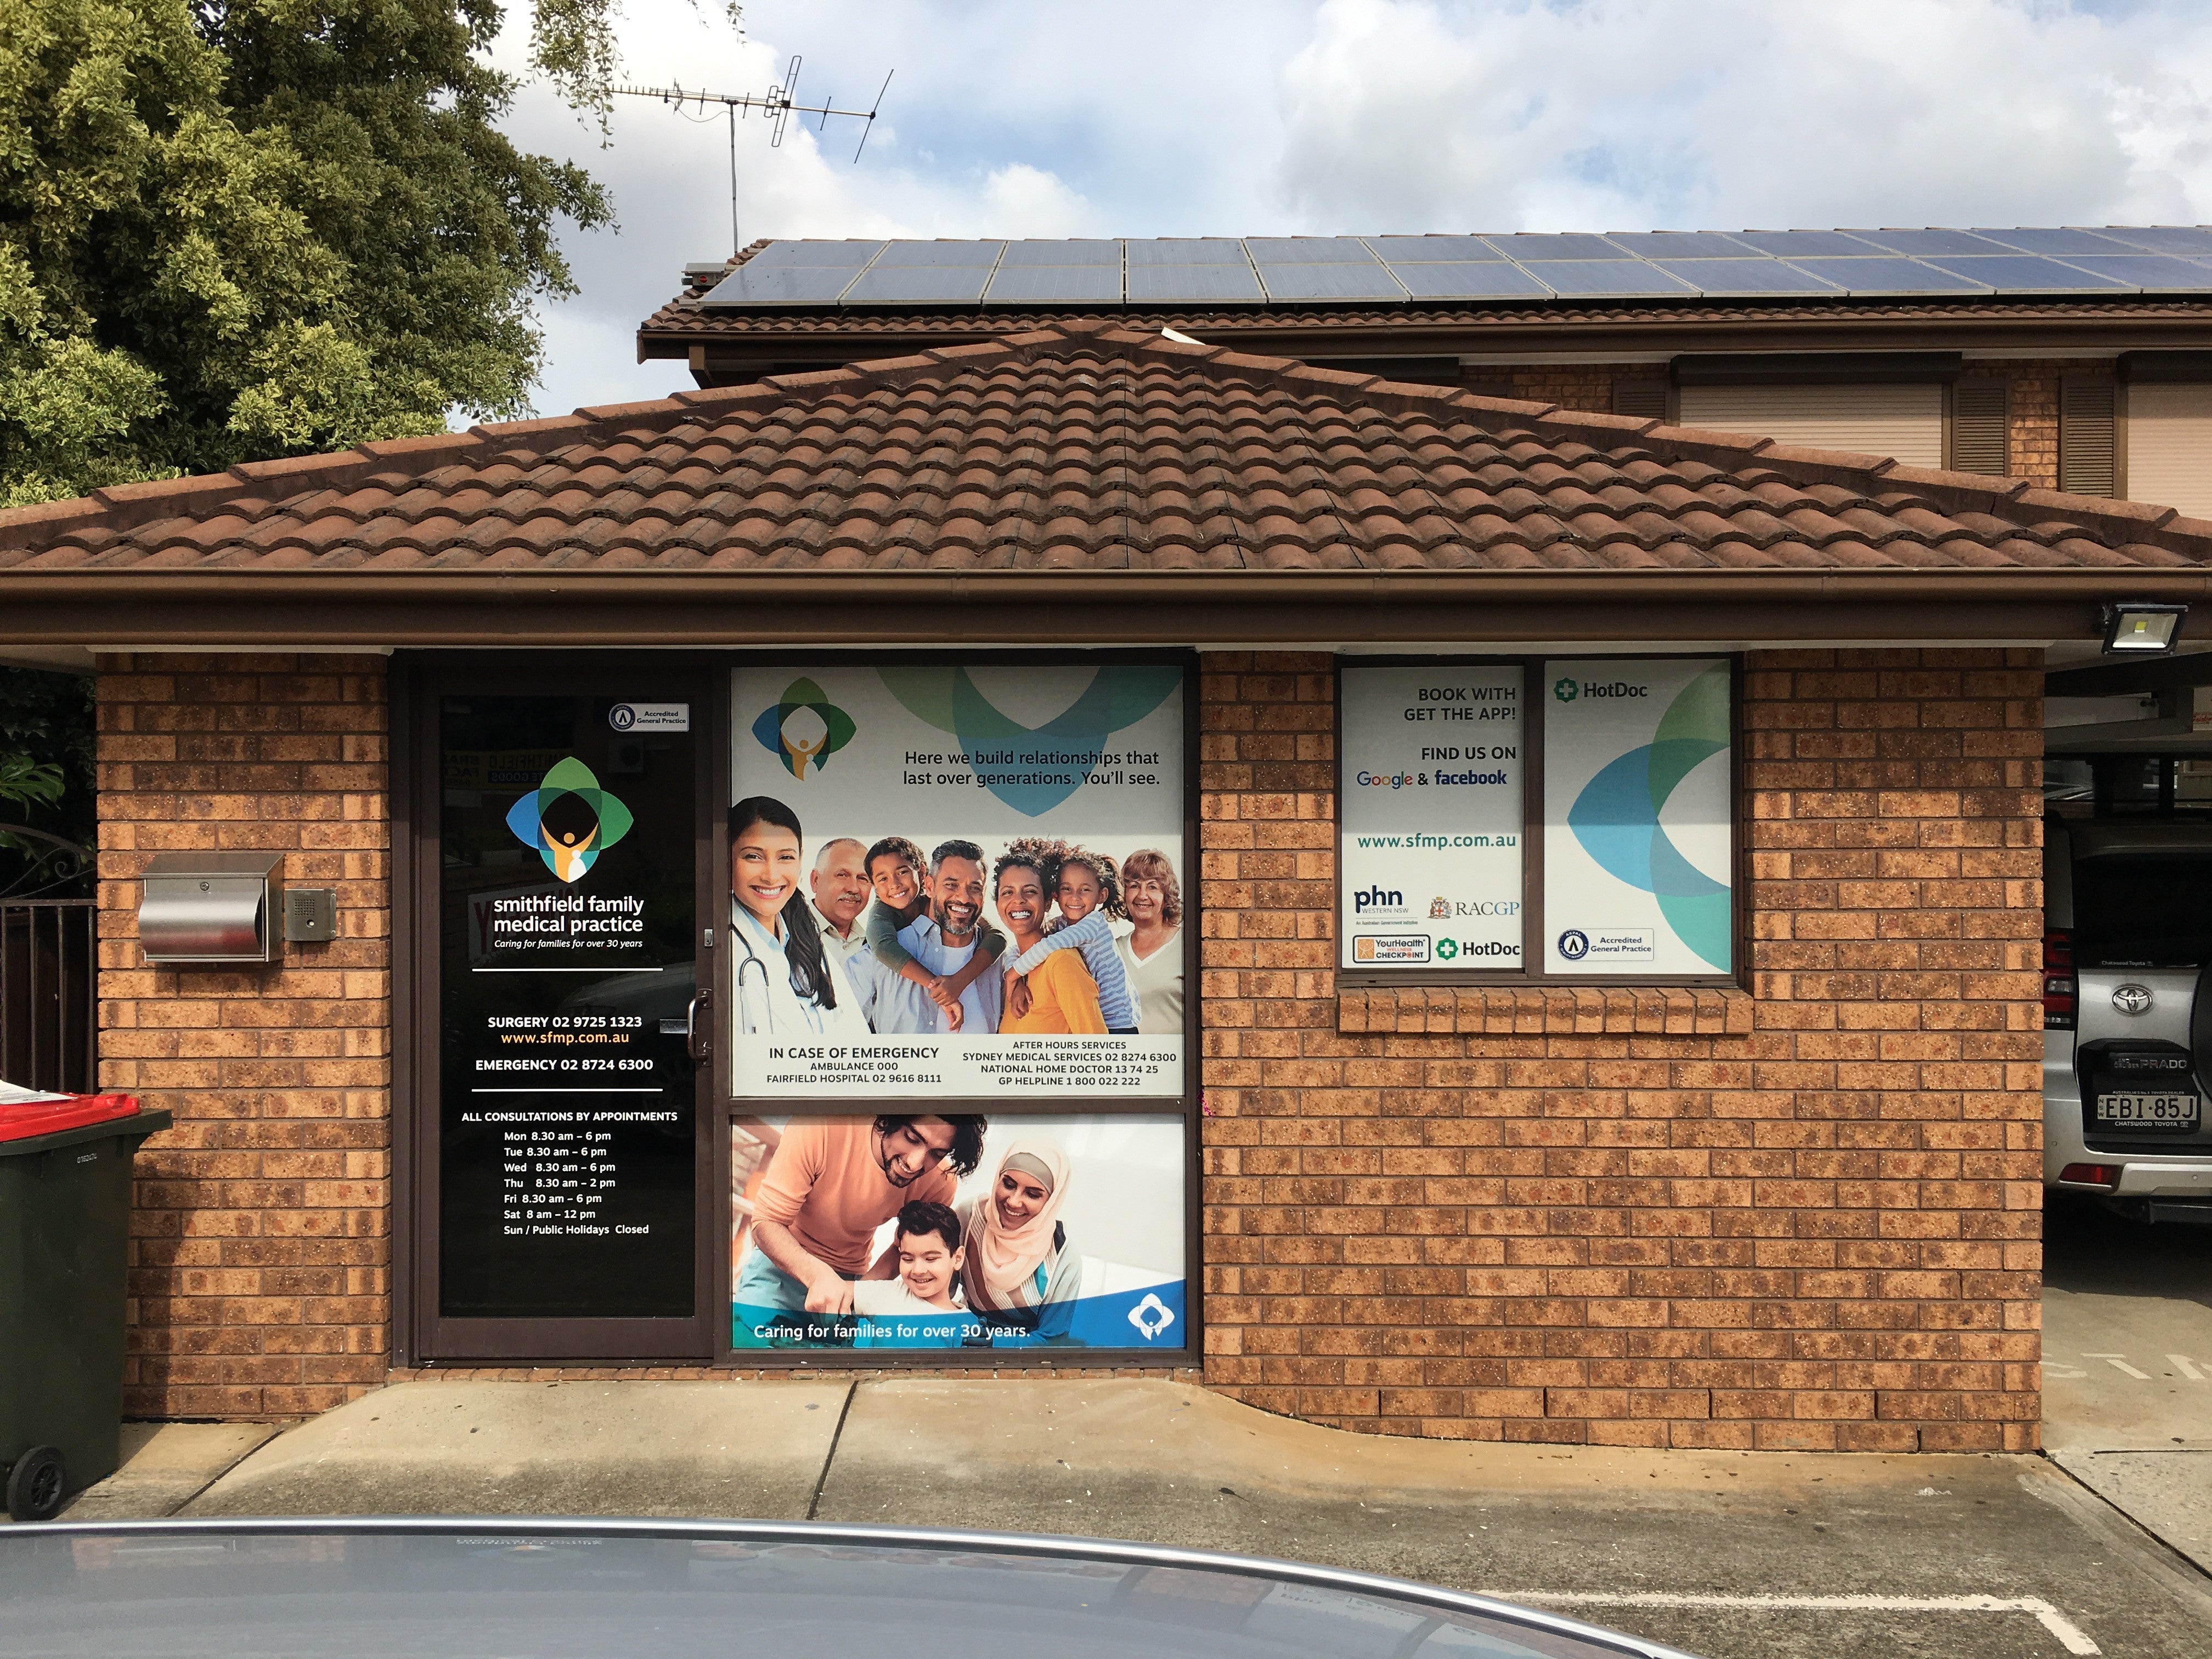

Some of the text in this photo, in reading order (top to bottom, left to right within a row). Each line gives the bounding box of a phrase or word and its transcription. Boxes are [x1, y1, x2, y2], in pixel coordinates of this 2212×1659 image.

[1419, 687, 1515, 701] BOOK WITH
[1583, 682, 1647, 698] HotDoc
[1404, 707, 1515, 720] GET THE APP!
[905, 750, 1159, 768] Here we build relationships that
[1422, 747, 1516, 760] FIND US ON
[904, 770, 1160, 788] last over generations. You'll see.
[1357, 770, 1507, 789] Google & facebook
[1358, 833, 1515, 850] www.sfmp.com.au
[494, 895, 644, 916] smithfield family
[1354, 885, 1402, 914] phn
[1455, 902, 1520, 916] RACGP
[495, 916, 642, 935] medical practice
[495, 940, 522, 949] Caring
[523, 940, 536, 949] for
[537, 939, 570, 949] families
[572, 939, 585, 949] for
[1463, 942, 1520, 955] HotDoc
[488, 1017, 642, 1028] SURGERY 02 9725 1323
[501, 1031, 629, 1046] www.sfmp.com.au
[770, 1048, 939, 1058] IN CASE OF EMERGENCY
[476, 1059, 653, 1070] EMERGENCY 02 8724 6300
[2140, 1059, 2187, 1069] PRADO
[462, 1112, 677, 1121] ALL CONSULTATIONS BY APPOINTMENTS
[532, 1132, 555, 1140] 8.30
[586, 1132, 592, 1140] 6
[596, 1133, 611, 1142] pm
[504, 1148, 522, 1156] Tue
[527, 1148, 550, 1156] 8.30
[582, 1147, 588, 1155] 6
[591, 1149, 606, 1158] pm
[504, 1163, 527, 1171] Wed
[536, 1163, 559, 1171] 8.30
[590, 1163, 596, 1171] 6
[600, 1165, 615, 1173] pm
[504, 1178, 523, 1187] Thu
[536, 1179, 559, 1187] 8.30
[590, 1178, 596, 1187] 2
[600, 1180, 615, 1189] pm
[505, 1194, 516, 1203] Fri
[522, 1194, 545, 1203] 8.30
[577, 1194, 583, 1203] 6
[586, 1196, 601, 1204] pm
[504, 1210, 520, 1218] Sat
[527, 1210, 533, 1218] 8
[565, 1210, 577, 1218] 12
[580, 1211, 595, 1220] pm
[533, 1225, 563, 1234] Public
[567, 1225, 609, 1235] Holidays
[616, 1224, 648, 1233] Closed
[754, 1324, 1030, 1341] Caring for families for over 30 years.
